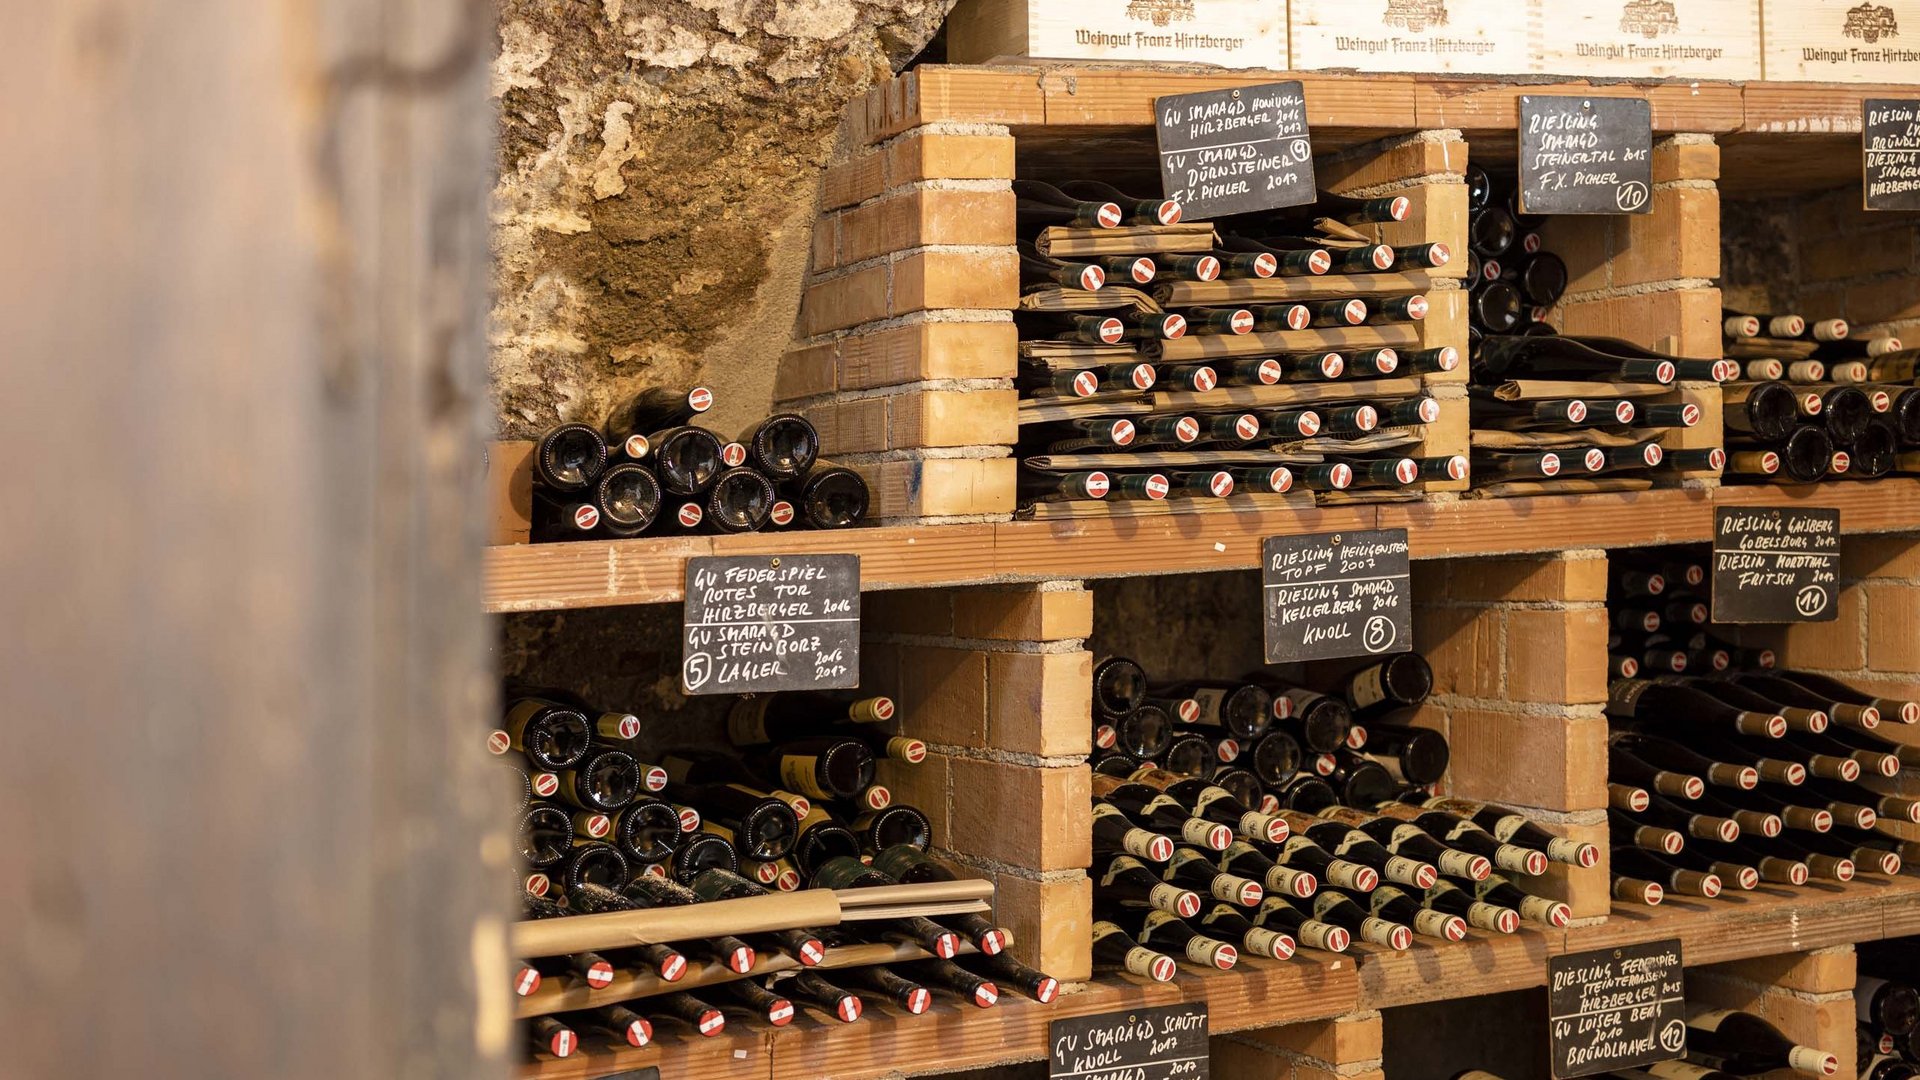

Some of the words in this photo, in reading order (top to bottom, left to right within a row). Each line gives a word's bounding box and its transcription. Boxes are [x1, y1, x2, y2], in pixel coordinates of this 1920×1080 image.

[1075, 29, 1132, 48] Weingut
[1134, 31, 1172, 48] Franz
[1175, 32, 1245, 51] Hirtzberger
[1335, 36, 1389, 55] Weingut
[1391, 38, 1427, 55] Franz
[1429, 38, 1496, 56] Hirtzberger
[1575, 43, 1625, 60] Weingut
[1627, 44, 1660, 59] Franz
[1662, 44, 1723, 61] Hirtzberger
[1802, 47, 1848, 64] Weingut
[1850, 48, 1880, 63] Franz
[1882, 47, 1920, 64] Hirtzbe
[1187, 100, 1245, 122] SMARAGD
[1276, 109, 1299, 125] 2016
[1277, 123, 1301, 138] 2017
[1539, 132, 1598, 152] SMARAGD
[1197, 145, 1257, 166] SMARAGD
[1623, 147, 1647, 161] 2015
[1267, 172, 1298, 191] 2017
[1739, 534, 1807, 551] GOBELSBURG
[1281, 563, 1327, 581] TOPF
[1339, 558, 1376, 574] 2007
[703, 585, 757, 605] ROTES
[774, 585, 811, 599] TOR
[823, 599, 851, 615] 2016
[1282, 599, 1362, 625] KELLERBERG
[1372, 595, 1399, 611] 2016
[717, 624, 795, 642] SMARAGD
[1303, 622, 1352, 645] KNOLL
[815, 649, 843, 666] 2016
[718, 661, 788, 683] LAGLER
[815, 665, 847, 681] 2017
[1630, 1003, 1662, 1022] BERG
[1083, 1020, 1154, 1051] SMARAGD
[1591, 1027, 1623, 1046] 2010
[1073, 1049, 1122, 1073] KNOLL
[1149, 1037, 1178, 1056] 2017
[1170, 1061, 1197, 1076] 2017
